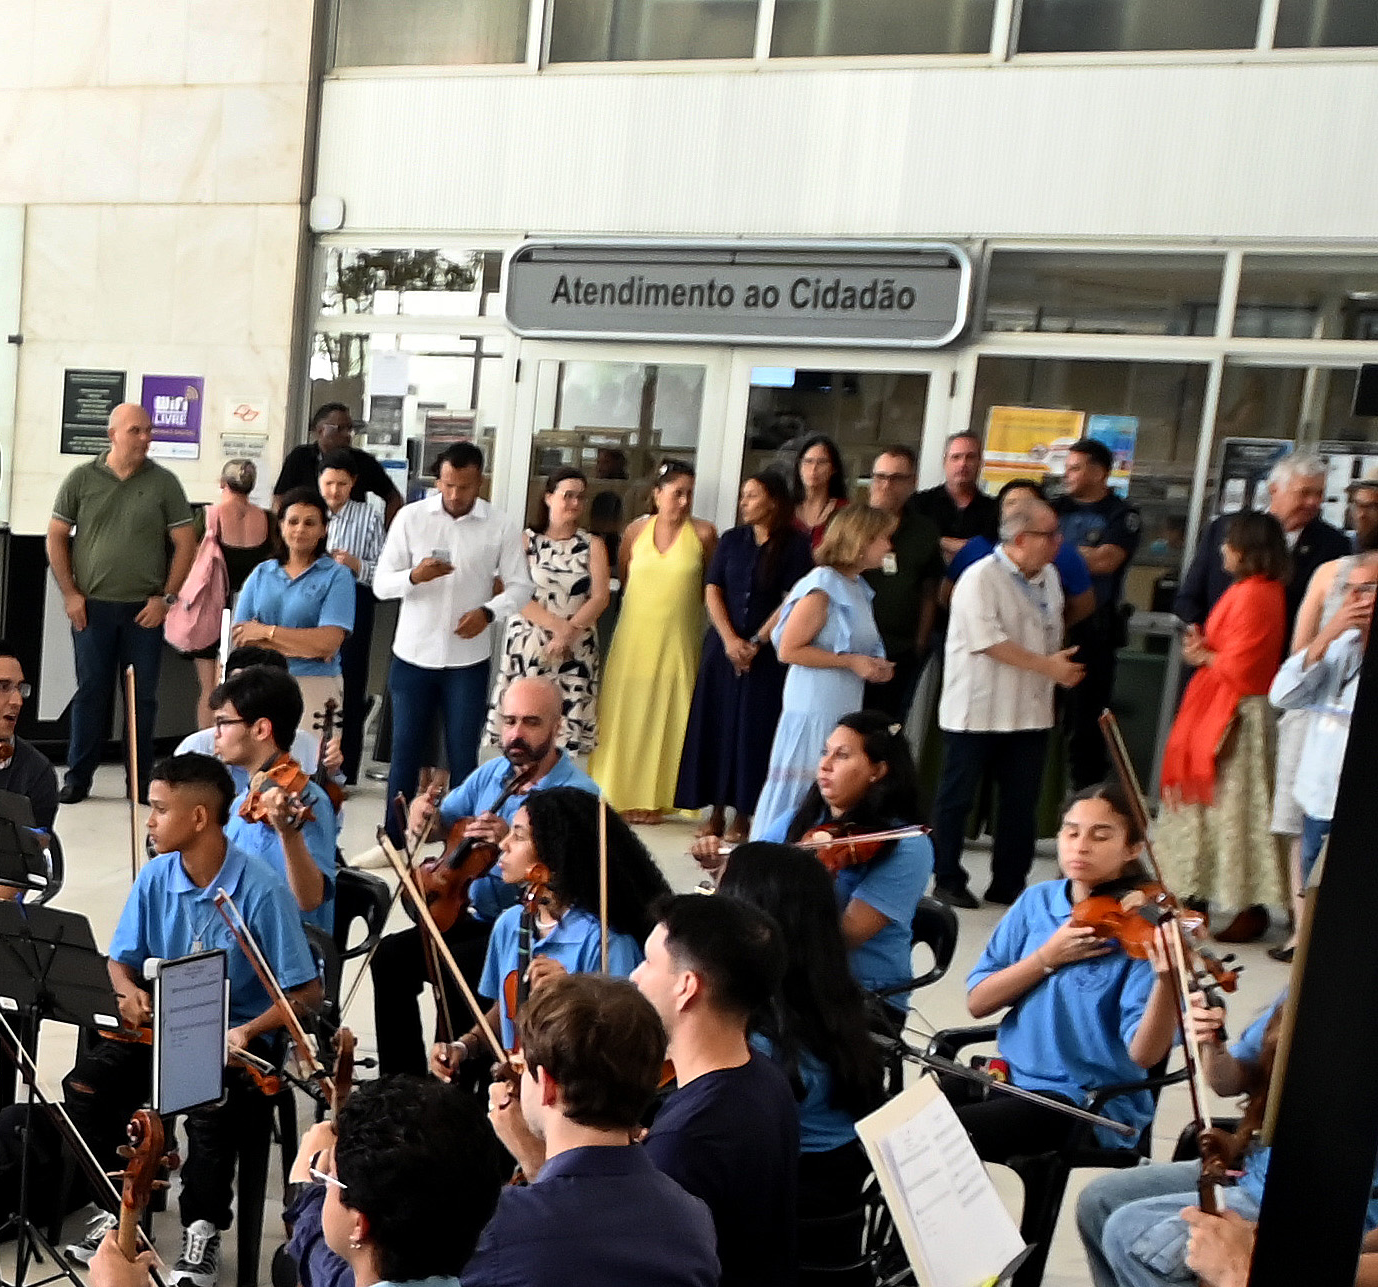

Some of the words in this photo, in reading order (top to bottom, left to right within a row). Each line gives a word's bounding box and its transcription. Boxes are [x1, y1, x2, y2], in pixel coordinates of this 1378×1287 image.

[551, 274, 735, 306] Atendimento
[744, 283, 780, 309] ao
[789, 277, 916, 310] Cidadão
[154, 413, 188, 426] LIVRE
